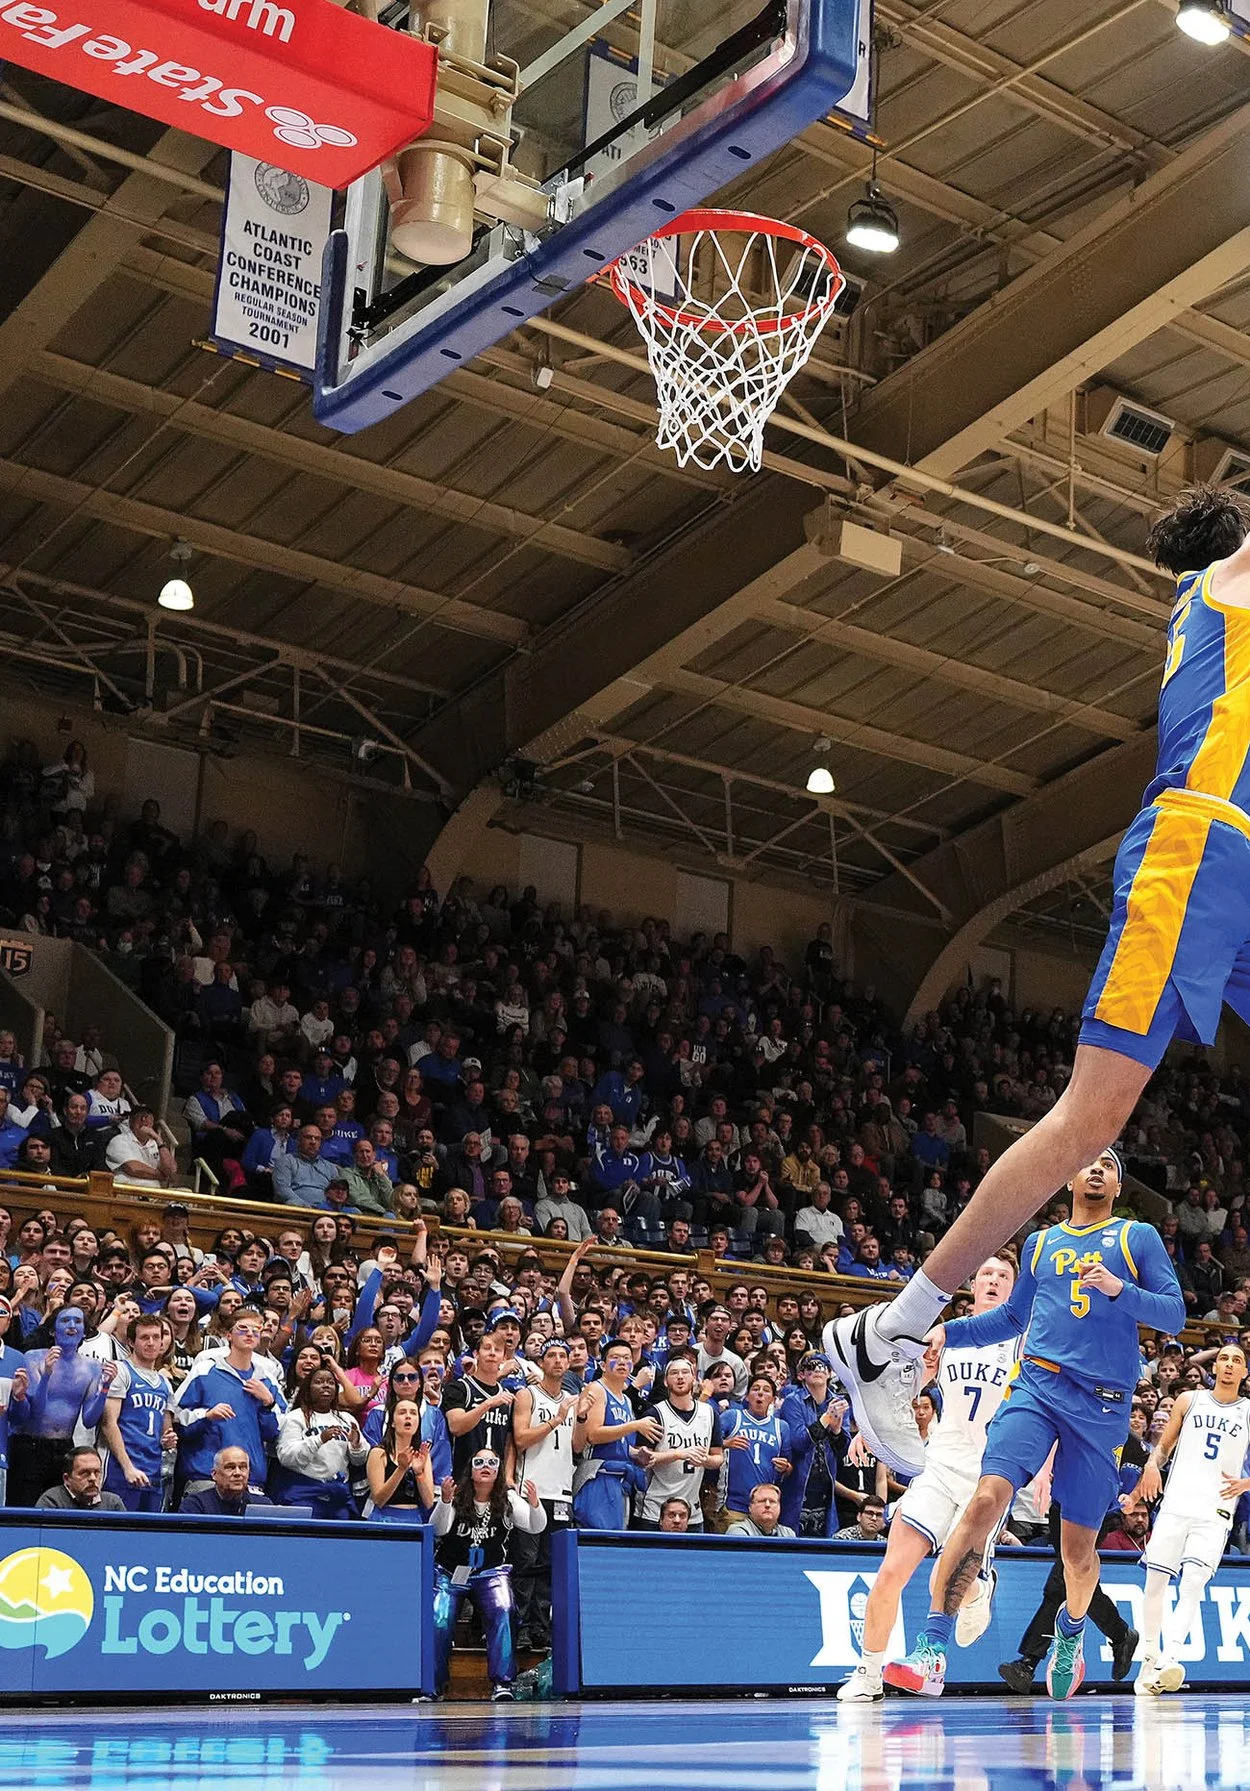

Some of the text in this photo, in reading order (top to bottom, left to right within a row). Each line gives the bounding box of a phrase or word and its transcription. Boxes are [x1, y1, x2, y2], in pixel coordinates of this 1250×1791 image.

[243, 219, 312, 256] ATLANTIC
[253, 242, 301, 270] COAST
[226, 251, 321, 299] CONFERENCE
[229, 271, 316, 317] CHAMPIONS
[234, 291, 308, 327] REGULAR SEASON
[242, 306, 300, 334] TOURNAMENT
[249, 322, 289, 349] 2001
[1070, 1280, 1091, 1319] 5
[947, 1362, 1007, 1387] DUKE
[964, 1386, 982, 1422] 7
[146, 1410, 154, 1436] 1
[1193, 1415, 1243, 1438] DUKE
[485, 1427, 492, 1449] 1
[553, 1429, 560, 1450] 1
[668, 1432, 708, 1450] Duke
[739, 1429, 777, 1447] DUKE
[1203, 1433, 1222, 1460] 5
[753, 1443, 761, 1465] 1
[104, 1565, 285, 1595] NC Education
[101, 1596, 344, 1671] Lottery
